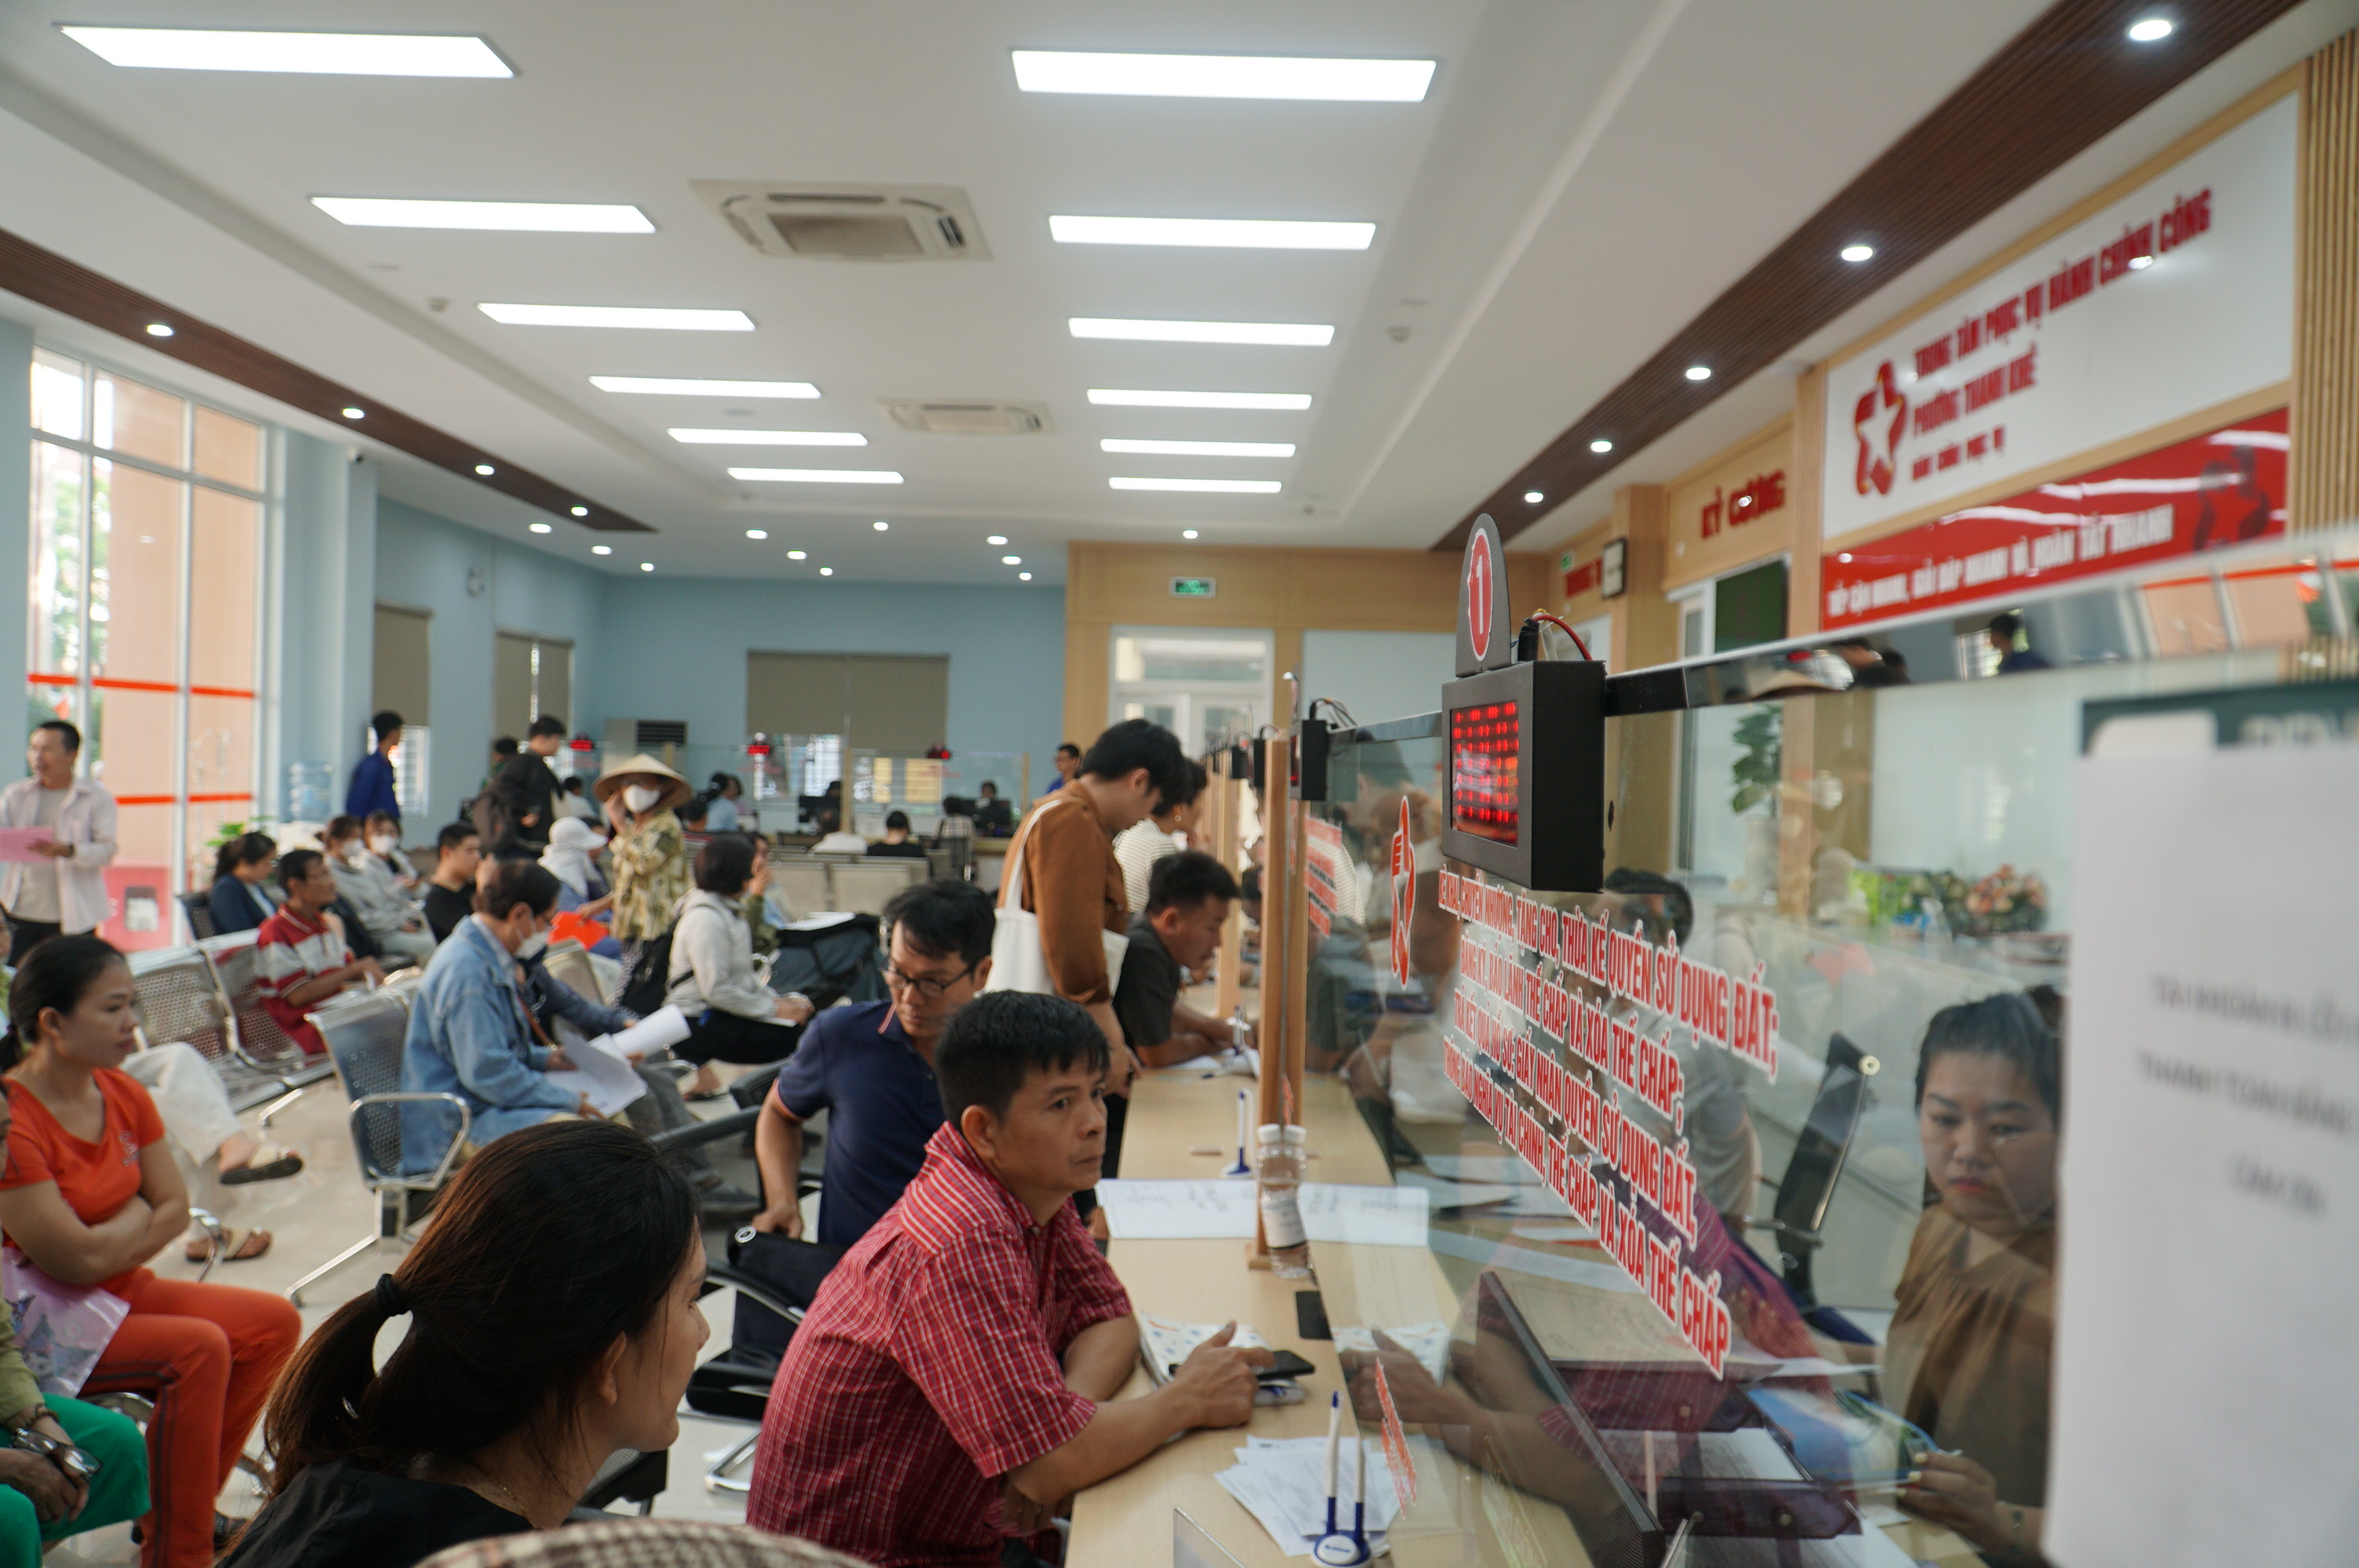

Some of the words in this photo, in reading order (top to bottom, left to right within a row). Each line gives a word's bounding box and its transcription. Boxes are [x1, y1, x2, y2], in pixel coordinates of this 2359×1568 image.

[1476, 554, 1485, 635] 1
[1503, 953, 1525, 1016] LÃNH
[1525, 961, 1543, 1028] THẾ
[1543, 970, 1568, 1044] CHẤP
[1569, 986, 1583, 1058] VÀ
[1584, 996, 1609, 1076] XÓA
[1612, 1010, 1639, 1094] THẾ
[1638, 1026, 1685, 1137] CHẤP;
[1516, 887, 1538, 956] TẶNG
[1539, 903, 1560, 969] CHO,
[1561, 906, 1589, 978] THỪA
[1590, 909, 1608, 987] KẾ
[1608, 919, 1653, 1010] QUYỀN
[1654, 930, 1680, 1021] SỬ
[1679, 955, 1729, 1050] DỤNG
[1732, 959, 1779, 1085] ĐẤT;
[1473, 1063, 1494, 1127] NGHĨA
[1494, 1082, 1505, 1145] VỤ
[1504, 1087, 1518, 1152] TÀI
[1518, 1106, 1547, 1189] CHÍNH,
[1548, 1132, 1568, 1204] THẾ
[1568, 1152, 1598, 1235] CHẤP
[1599, 1180, 1616, 1261] VÀ
[1616, 1201, 1646, 1294] XÓA
[1648, 1235, 1681, 1329] THẾ
[1681, 1269, 1732, 1381] CHẤP
[1516, 1025, 1536, 1096] GIẤY
[1535, 1048, 1563, 1125] NHẬN
[1564, 1069, 1601, 1155] QUYỀN
[1601, 1088, 1622, 1171] SỬ
[1620, 1114, 1661, 1210] DỤNG
[1662, 1137, 1698, 1253] ĐẤT,
